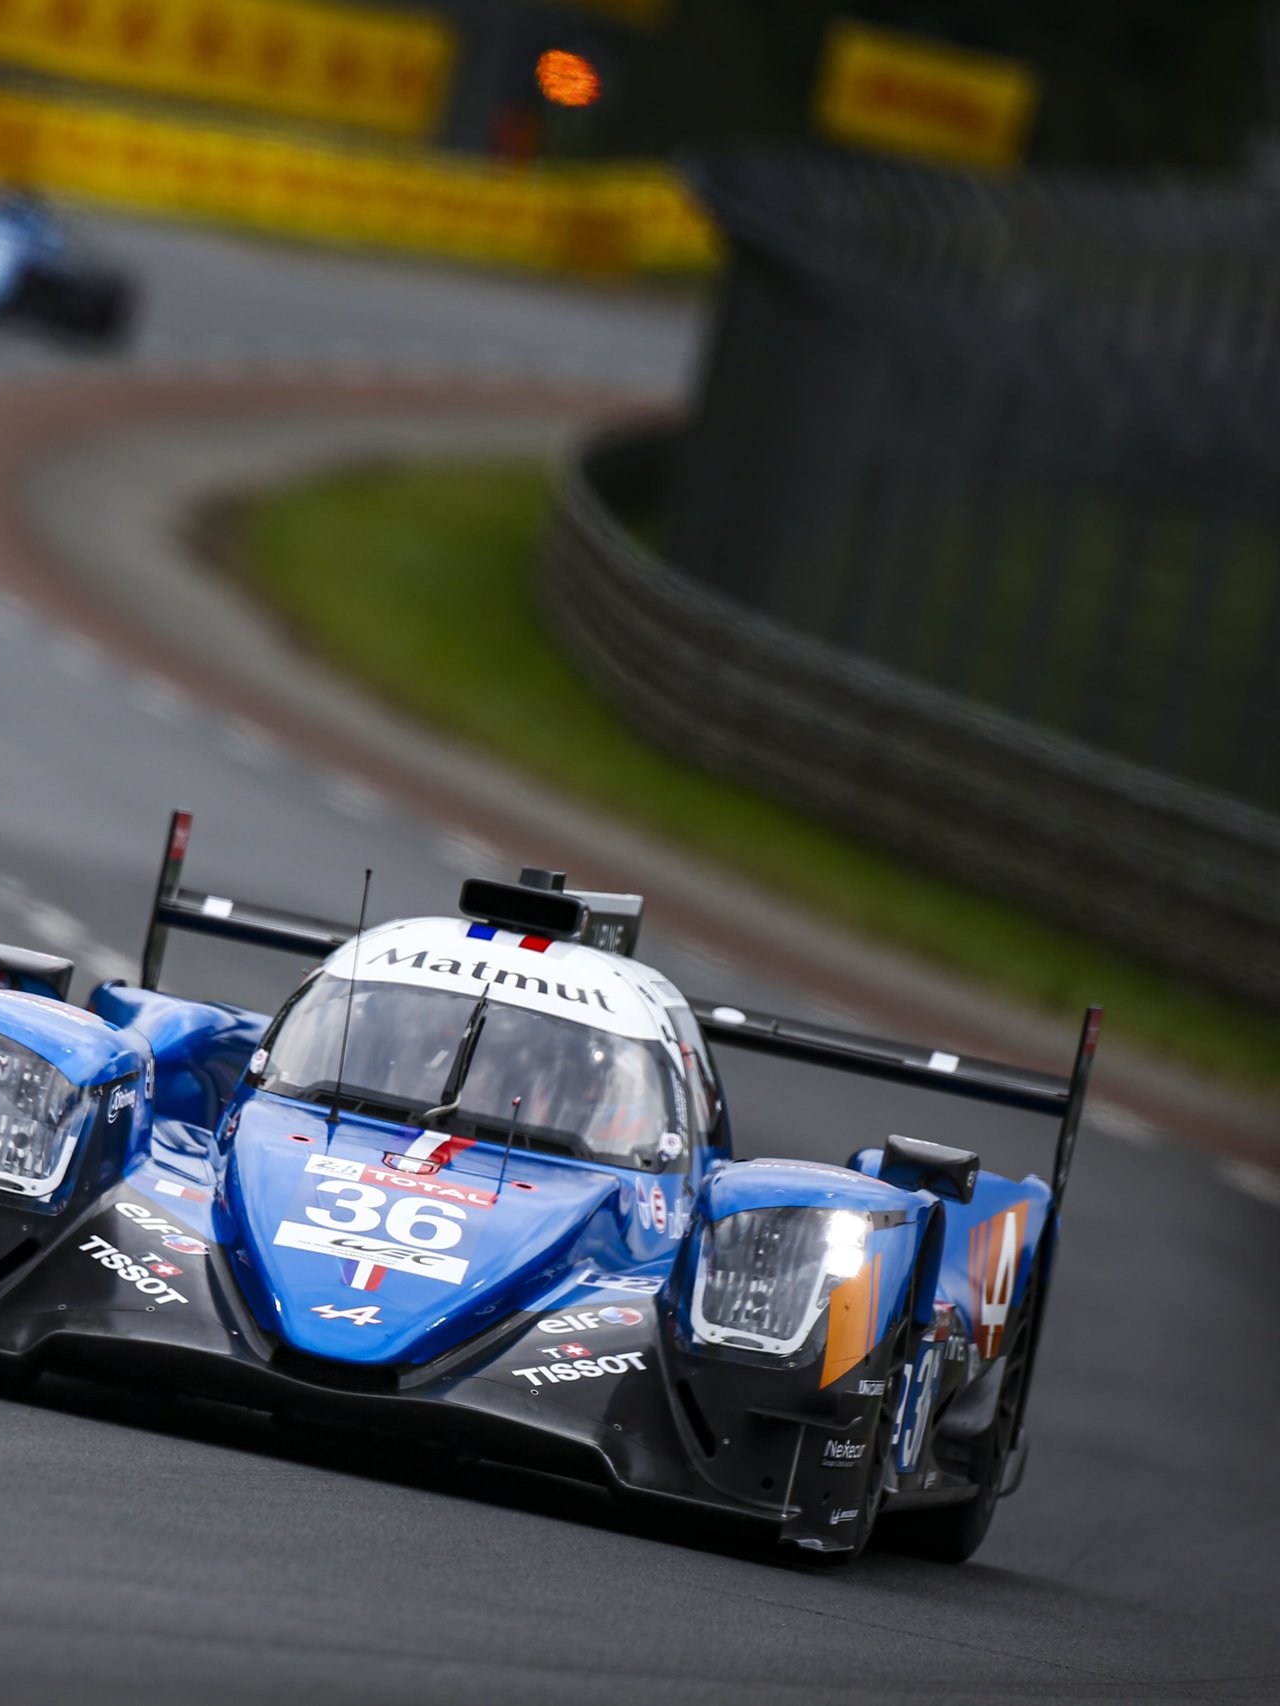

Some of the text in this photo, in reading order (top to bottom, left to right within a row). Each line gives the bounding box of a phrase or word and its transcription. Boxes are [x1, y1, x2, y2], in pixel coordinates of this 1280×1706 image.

[366, 948, 616, 1014] Matmut
[368, 1169, 490, 1206] TOTAL
[115, 1202, 183, 1235] elf
[305, 1180, 467, 1250] 36
[79, 1235, 189, 1304] TISSOT
[330, 1238, 446, 1266] WEC
[537, 1312, 601, 1334] elf
[511, 1351, 647, 1386] TISSOT
